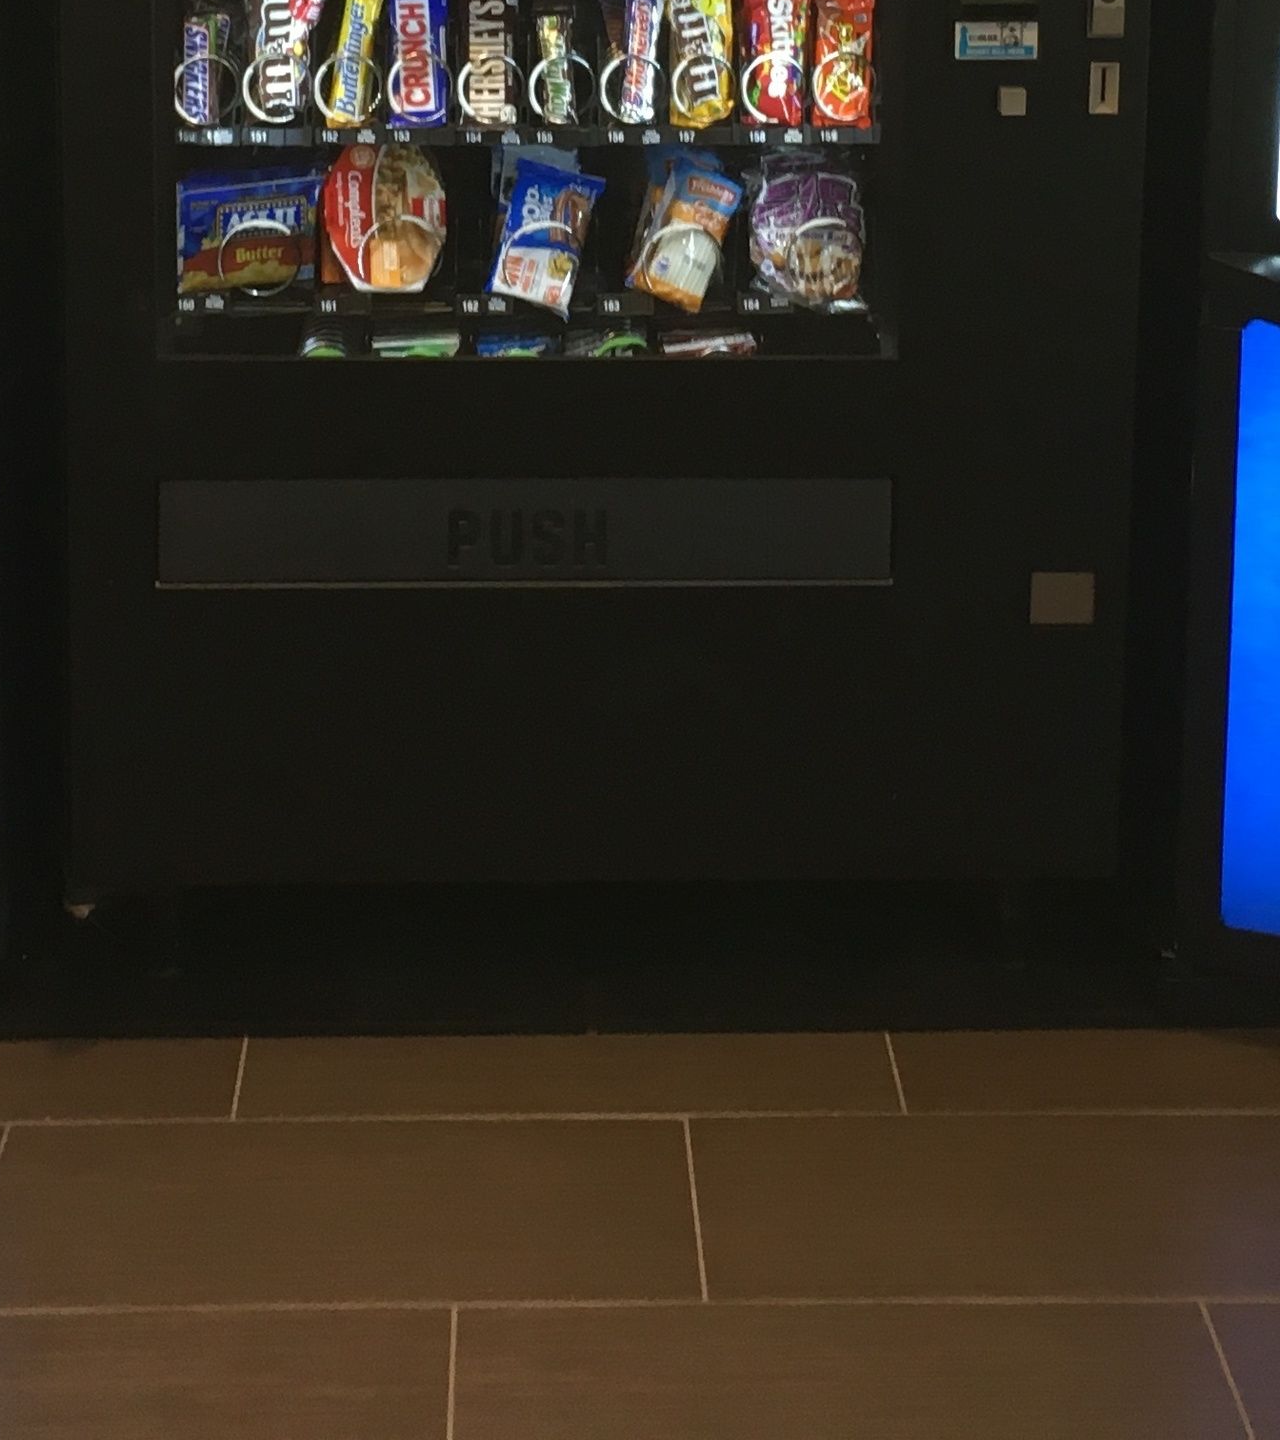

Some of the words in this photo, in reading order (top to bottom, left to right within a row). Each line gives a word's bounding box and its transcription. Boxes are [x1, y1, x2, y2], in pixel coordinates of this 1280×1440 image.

[335, 1, 368, 117] Butterfinger
[400, 2, 431, 108] CRUNCH
[184, 25, 209, 123] SNICKERS
[251, 131, 268, 143] 151
[322, 131, 339, 143] 152
[465, 132, 482, 144] 154
[679, 131, 695, 143] 157
[344, 169, 364, 249] Compleats
[227, 207, 271, 234] ACT
[235, 246, 285, 264] Butter
[321, 300, 337, 313] 161
[743, 298, 760, 312] 164
[448, 508, 609, 567] PUSH
